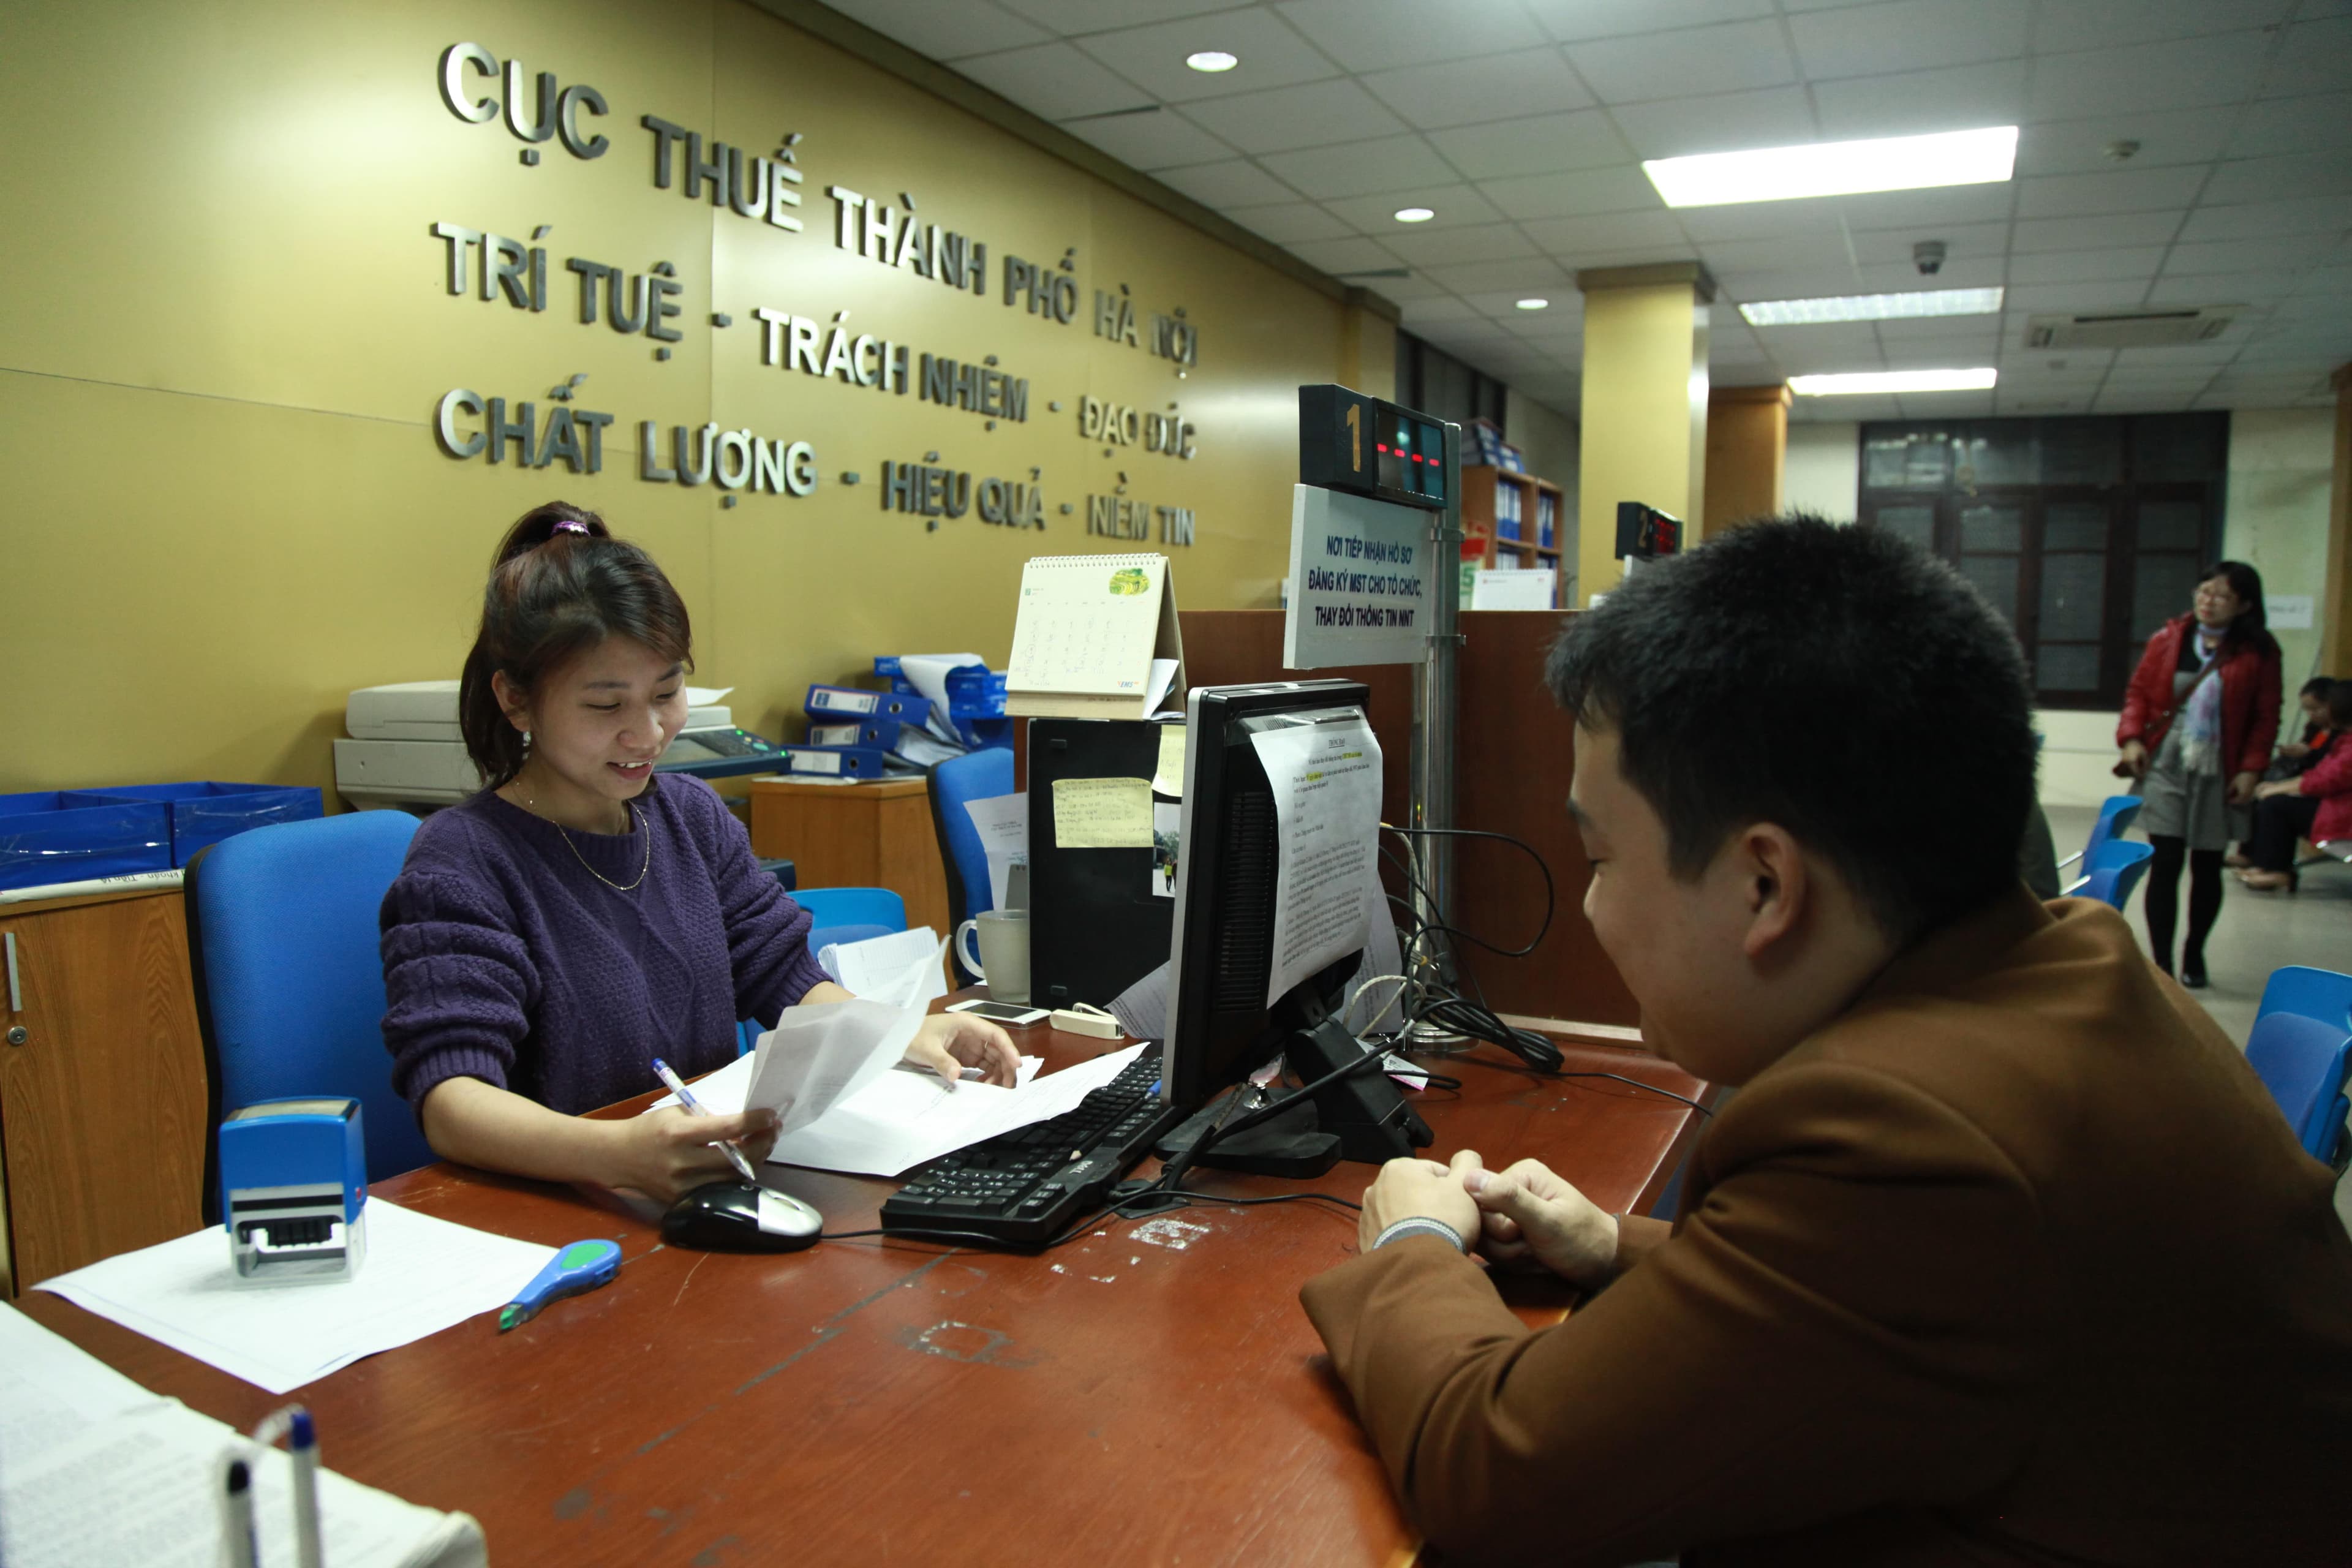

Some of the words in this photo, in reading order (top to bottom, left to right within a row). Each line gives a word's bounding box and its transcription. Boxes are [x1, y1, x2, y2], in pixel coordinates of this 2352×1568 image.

[439, 42, 610, 166] CỤC
[641, 114, 804, 233] THUẾ
[824, 186, 987, 296] THÀNH
[1003, 247, 1078, 325] PHỐ
[1093, 282, 1140, 348] HÀ
[1150, 306, 1197, 380] NỘI
[430, 221, 552, 311] TRÍ
[567, 260, 683, 361] TUỆ
[753, 307, 909, 395] TRÁCH
[919, 352, 1029, 431] NHIỆM
[1079, 396, 1139, 458] ĐẠO
[1144, 401, 1196, 460] ĐỨC
[434, 374, 614, 473] CHẤT
[640, 420, 818, 508] LƯỢNG
[880, 450, 971, 533] HIỆU
[976, 466, 1046, 531] QUẢ
[1086, 470, 1150, 541] NIỀM
[1155, 505, 1196, 547] TIN
[1346, 403, 1361, 472] 1
[1327, 535, 1343, 557] NƠI
[1401, 546, 1413, 565] SƠ
[1308, 566, 1334, 591] ĐĂNG
[1336, 568, 1348, 592] KÝ
[1349, 573, 1367, 593] MST
[1368, 575, 1385, 595] CHO
[1399, 575, 1422, 599] CHỨC,
[1316, 606, 1338, 627] THAY
[1356, 603, 1384, 627] THÔNG
[1385, 608, 1398, 627] TIN
[1398, 609, 1415, 627] NNT
[1068, 1160, 1093, 1174] DELL
